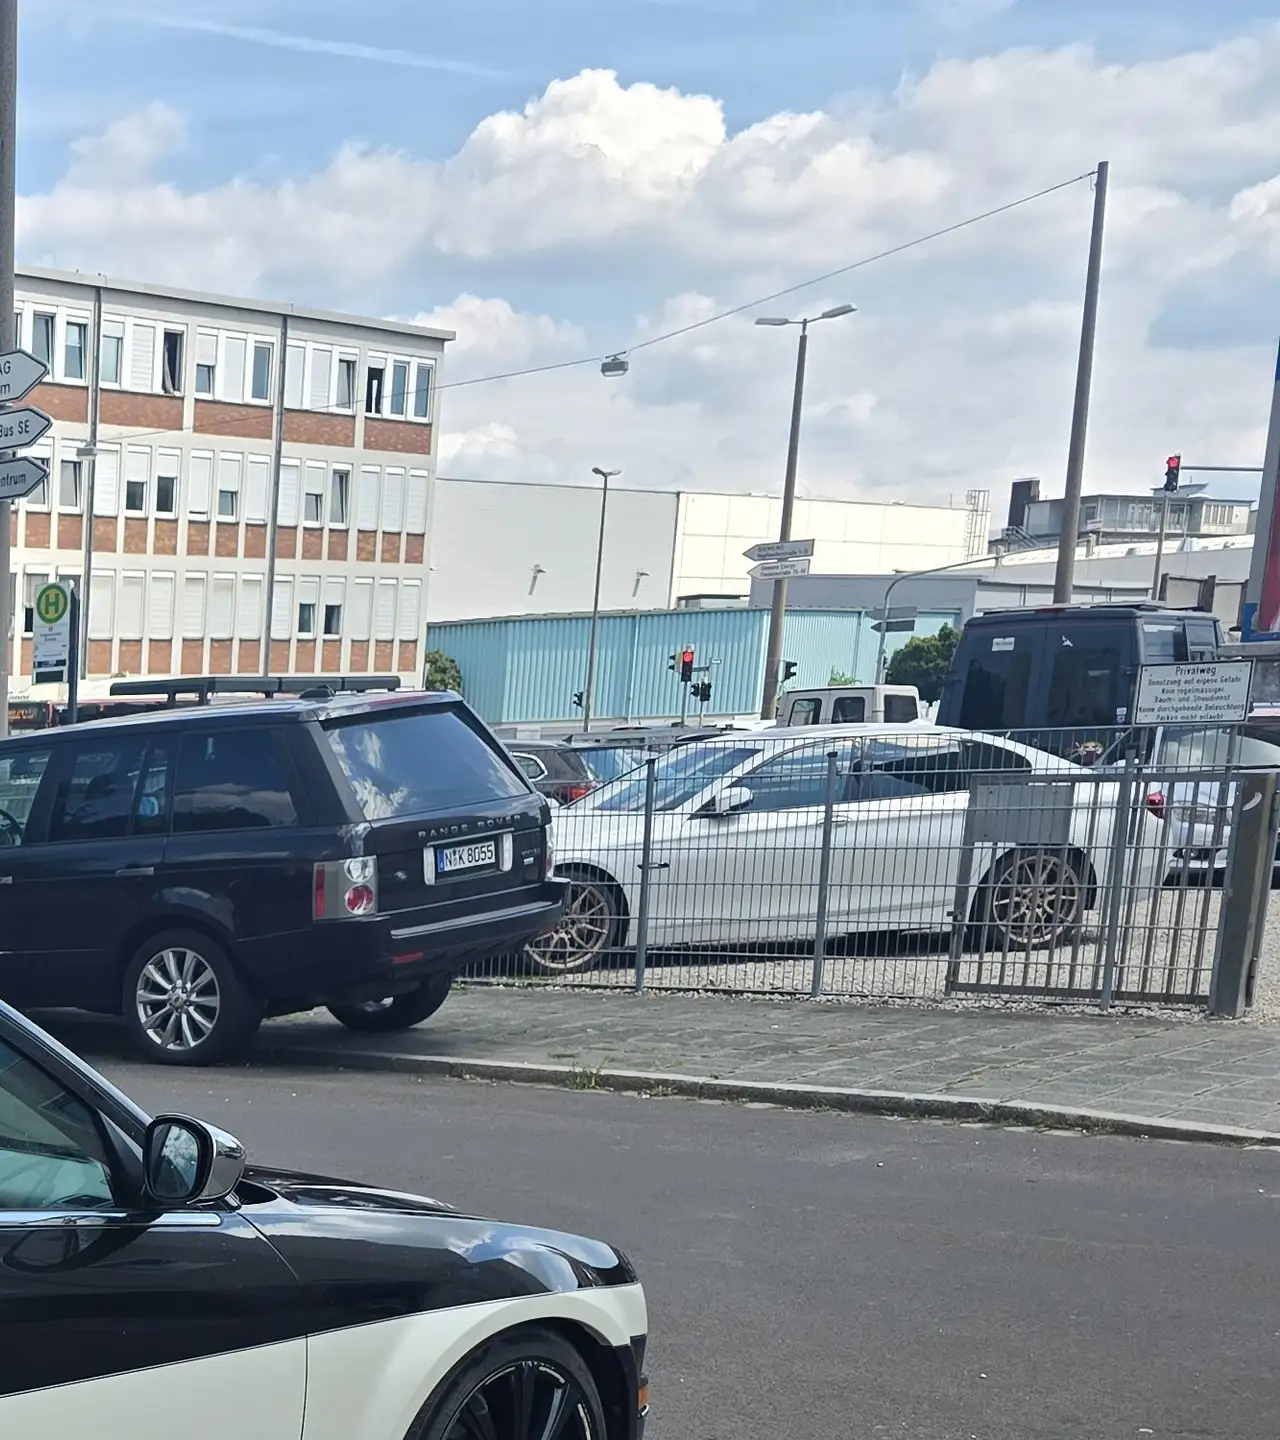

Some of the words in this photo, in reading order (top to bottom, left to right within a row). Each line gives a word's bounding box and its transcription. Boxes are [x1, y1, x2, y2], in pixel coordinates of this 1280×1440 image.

[18, 420, 30, 435] SE
[44, 592, 60, 615] H
[1175, 666, 1216, 676] Privatweg
[418, 824, 469, 838] RANGE
[477, 814, 521, 828] ROVER
[467, 844, 494, 863] 8055
